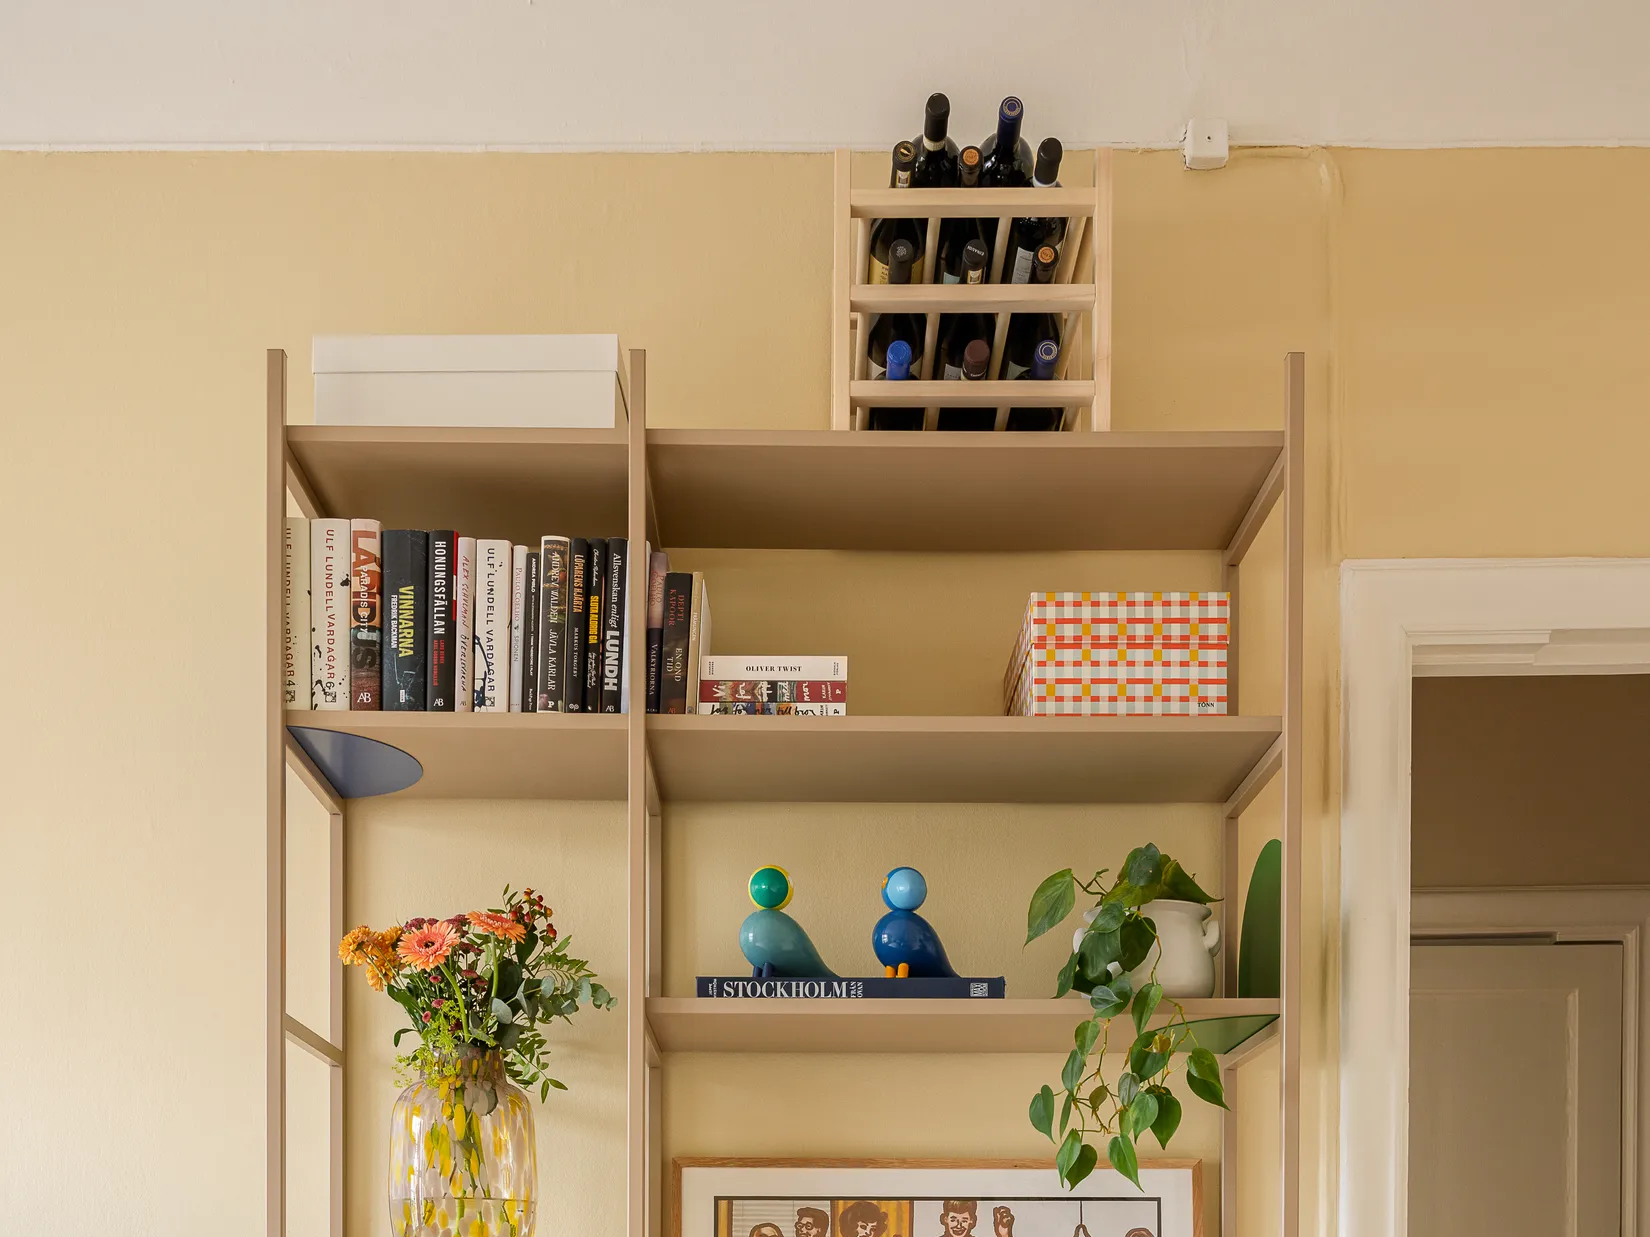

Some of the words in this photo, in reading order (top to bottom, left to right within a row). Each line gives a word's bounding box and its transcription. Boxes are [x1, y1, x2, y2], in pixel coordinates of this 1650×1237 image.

[325, 529, 334, 552] ULF
[462, 555, 470, 580] ALEX
[487, 548, 495, 569] ULF
[550, 551, 560, 589] ANDREV
[573, 554, 584, 588] LÖPARENS
[325, 556, 334, 612] LUNDELL
[360, 565, 369, 608] PARADIS
[433, 541, 448, 635] HONUNGSFÄLLAN
[515, 567, 523, 591] PAULO
[612, 553, 622, 602] Allsvenskan
[650, 570, 658, 607] COELHO
[656, 574, 665, 604] PAULO
[460, 582, 470, 629] SCHULMAN
[486, 573, 495, 625] LUNDELL
[513, 591, 522, 622] COELHO
[550, 589, 559, 624] WALDEN
[573, 588, 584, 613] HJÄRTA
[668, 589, 677, 626] KAPOOR
[677, 594, 685, 622] DEPTI
[360, 611, 369, 634] CITY
[399, 585, 415, 657] VINNARNA
[609, 603, 618, 628] enligt
[325, 613, 336, 680] VARDAGAR
[548, 628, 558, 655] JÄVLA
[675, 647, 683, 660] EN
[460, 633, 469, 692] ÖVERLEVARNA
[486, 629, 496, 693] VARDAGAR
[547, 656, 557, 691] KARLAR
[604, 630, 620, 691] LUNDH
[649, 643, 658, 696] VALKYRIORNA
[666, 656, 674, 672] TID
[674, 661, 682, 682] OND
[326, 681, 334, 690] 6
[357, 692, 372, 703] AB
[712, 684, 726, 697] Vi
[735, 682, 751, 699] for
[433, 698, 444, 707] AB
[723, 980, 848, 999] STOCKHOLM
